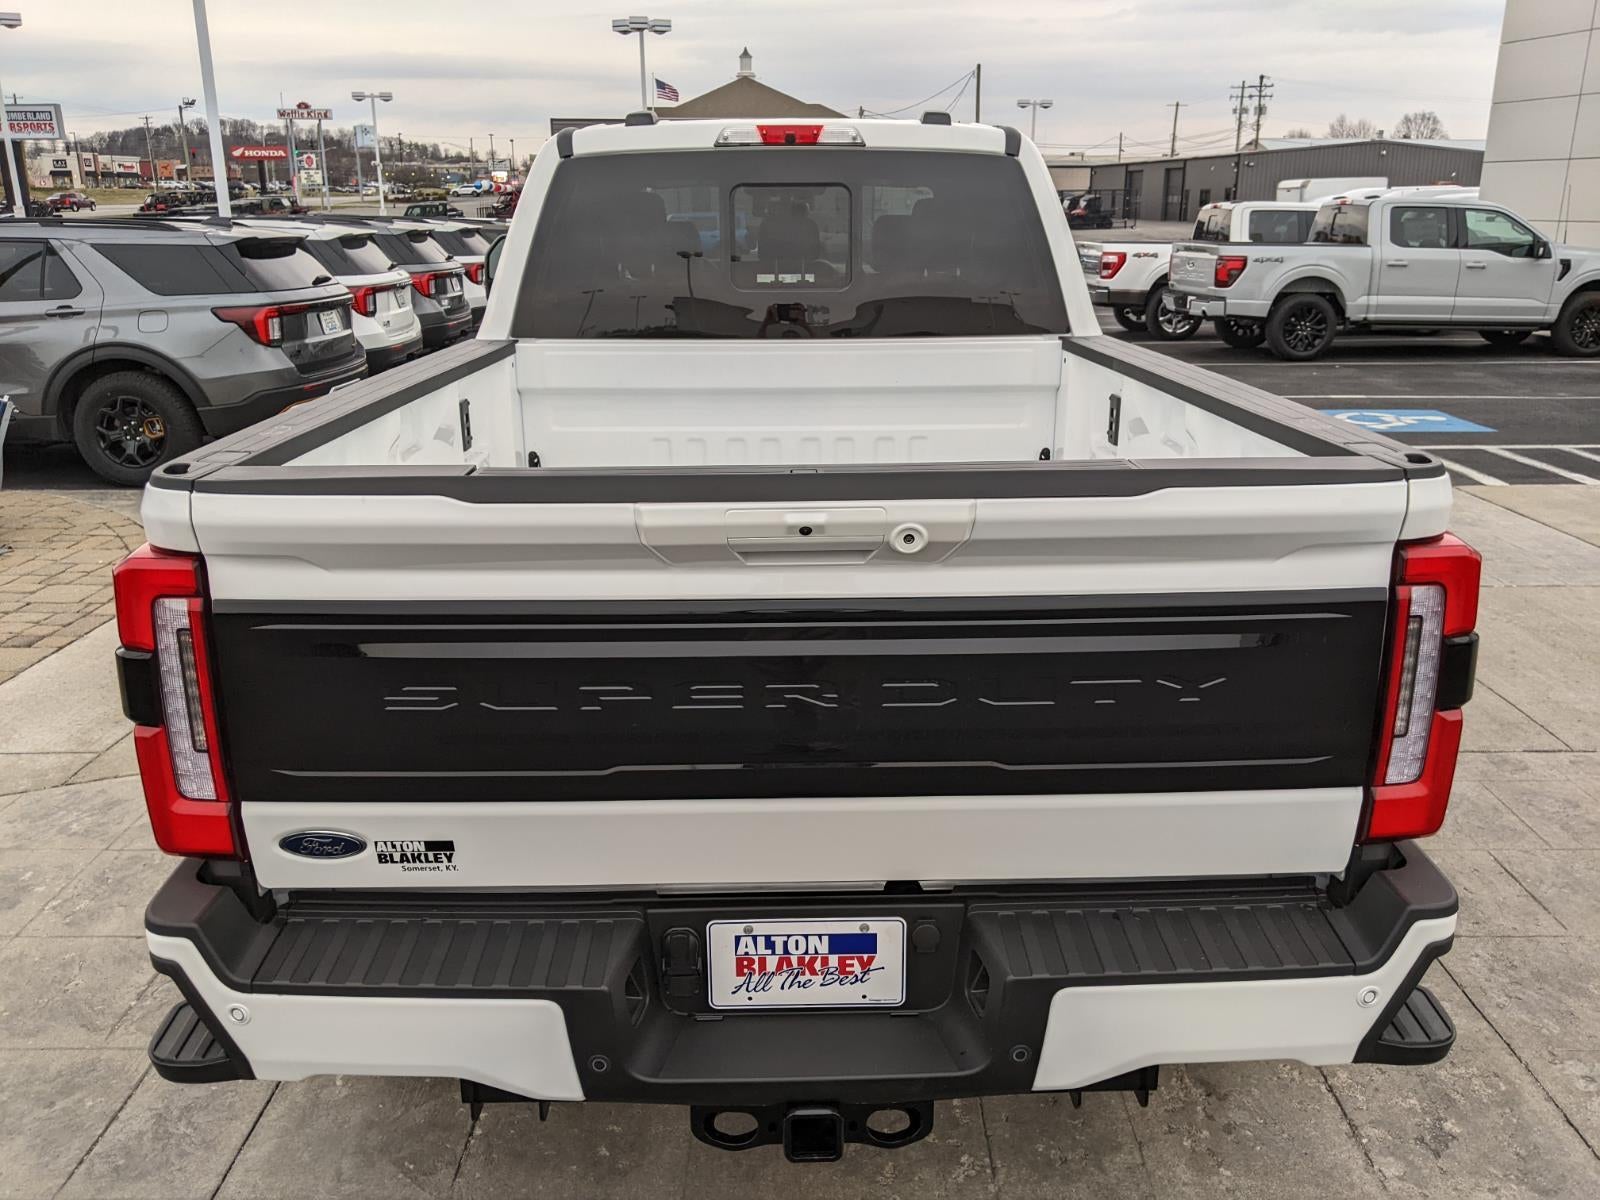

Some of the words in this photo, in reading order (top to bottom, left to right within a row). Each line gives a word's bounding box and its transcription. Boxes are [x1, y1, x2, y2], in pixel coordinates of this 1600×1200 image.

[6, 111, 51, 120] UMBERLAND
[306, 109, 329, 119] King
[244, 149, 286, 157] HONDA
[383, 683, 840, 712] SUPER
[881, 676, 1227, 709] DUTY
[300, 837, 345, 855] Ford
[376, 841, 426, 852] ALTON
[377, 852, 455, 864] BLAKLEY
[401, 864, 443, 872] Somerset,
[735, 935, 829, 955] ALTON
[735, 955, 878, 977] BLAKLEY
[731, 971, 774, 995] All
[776, 966, 815, 991] The
[819, 966, 885, 987] Best
